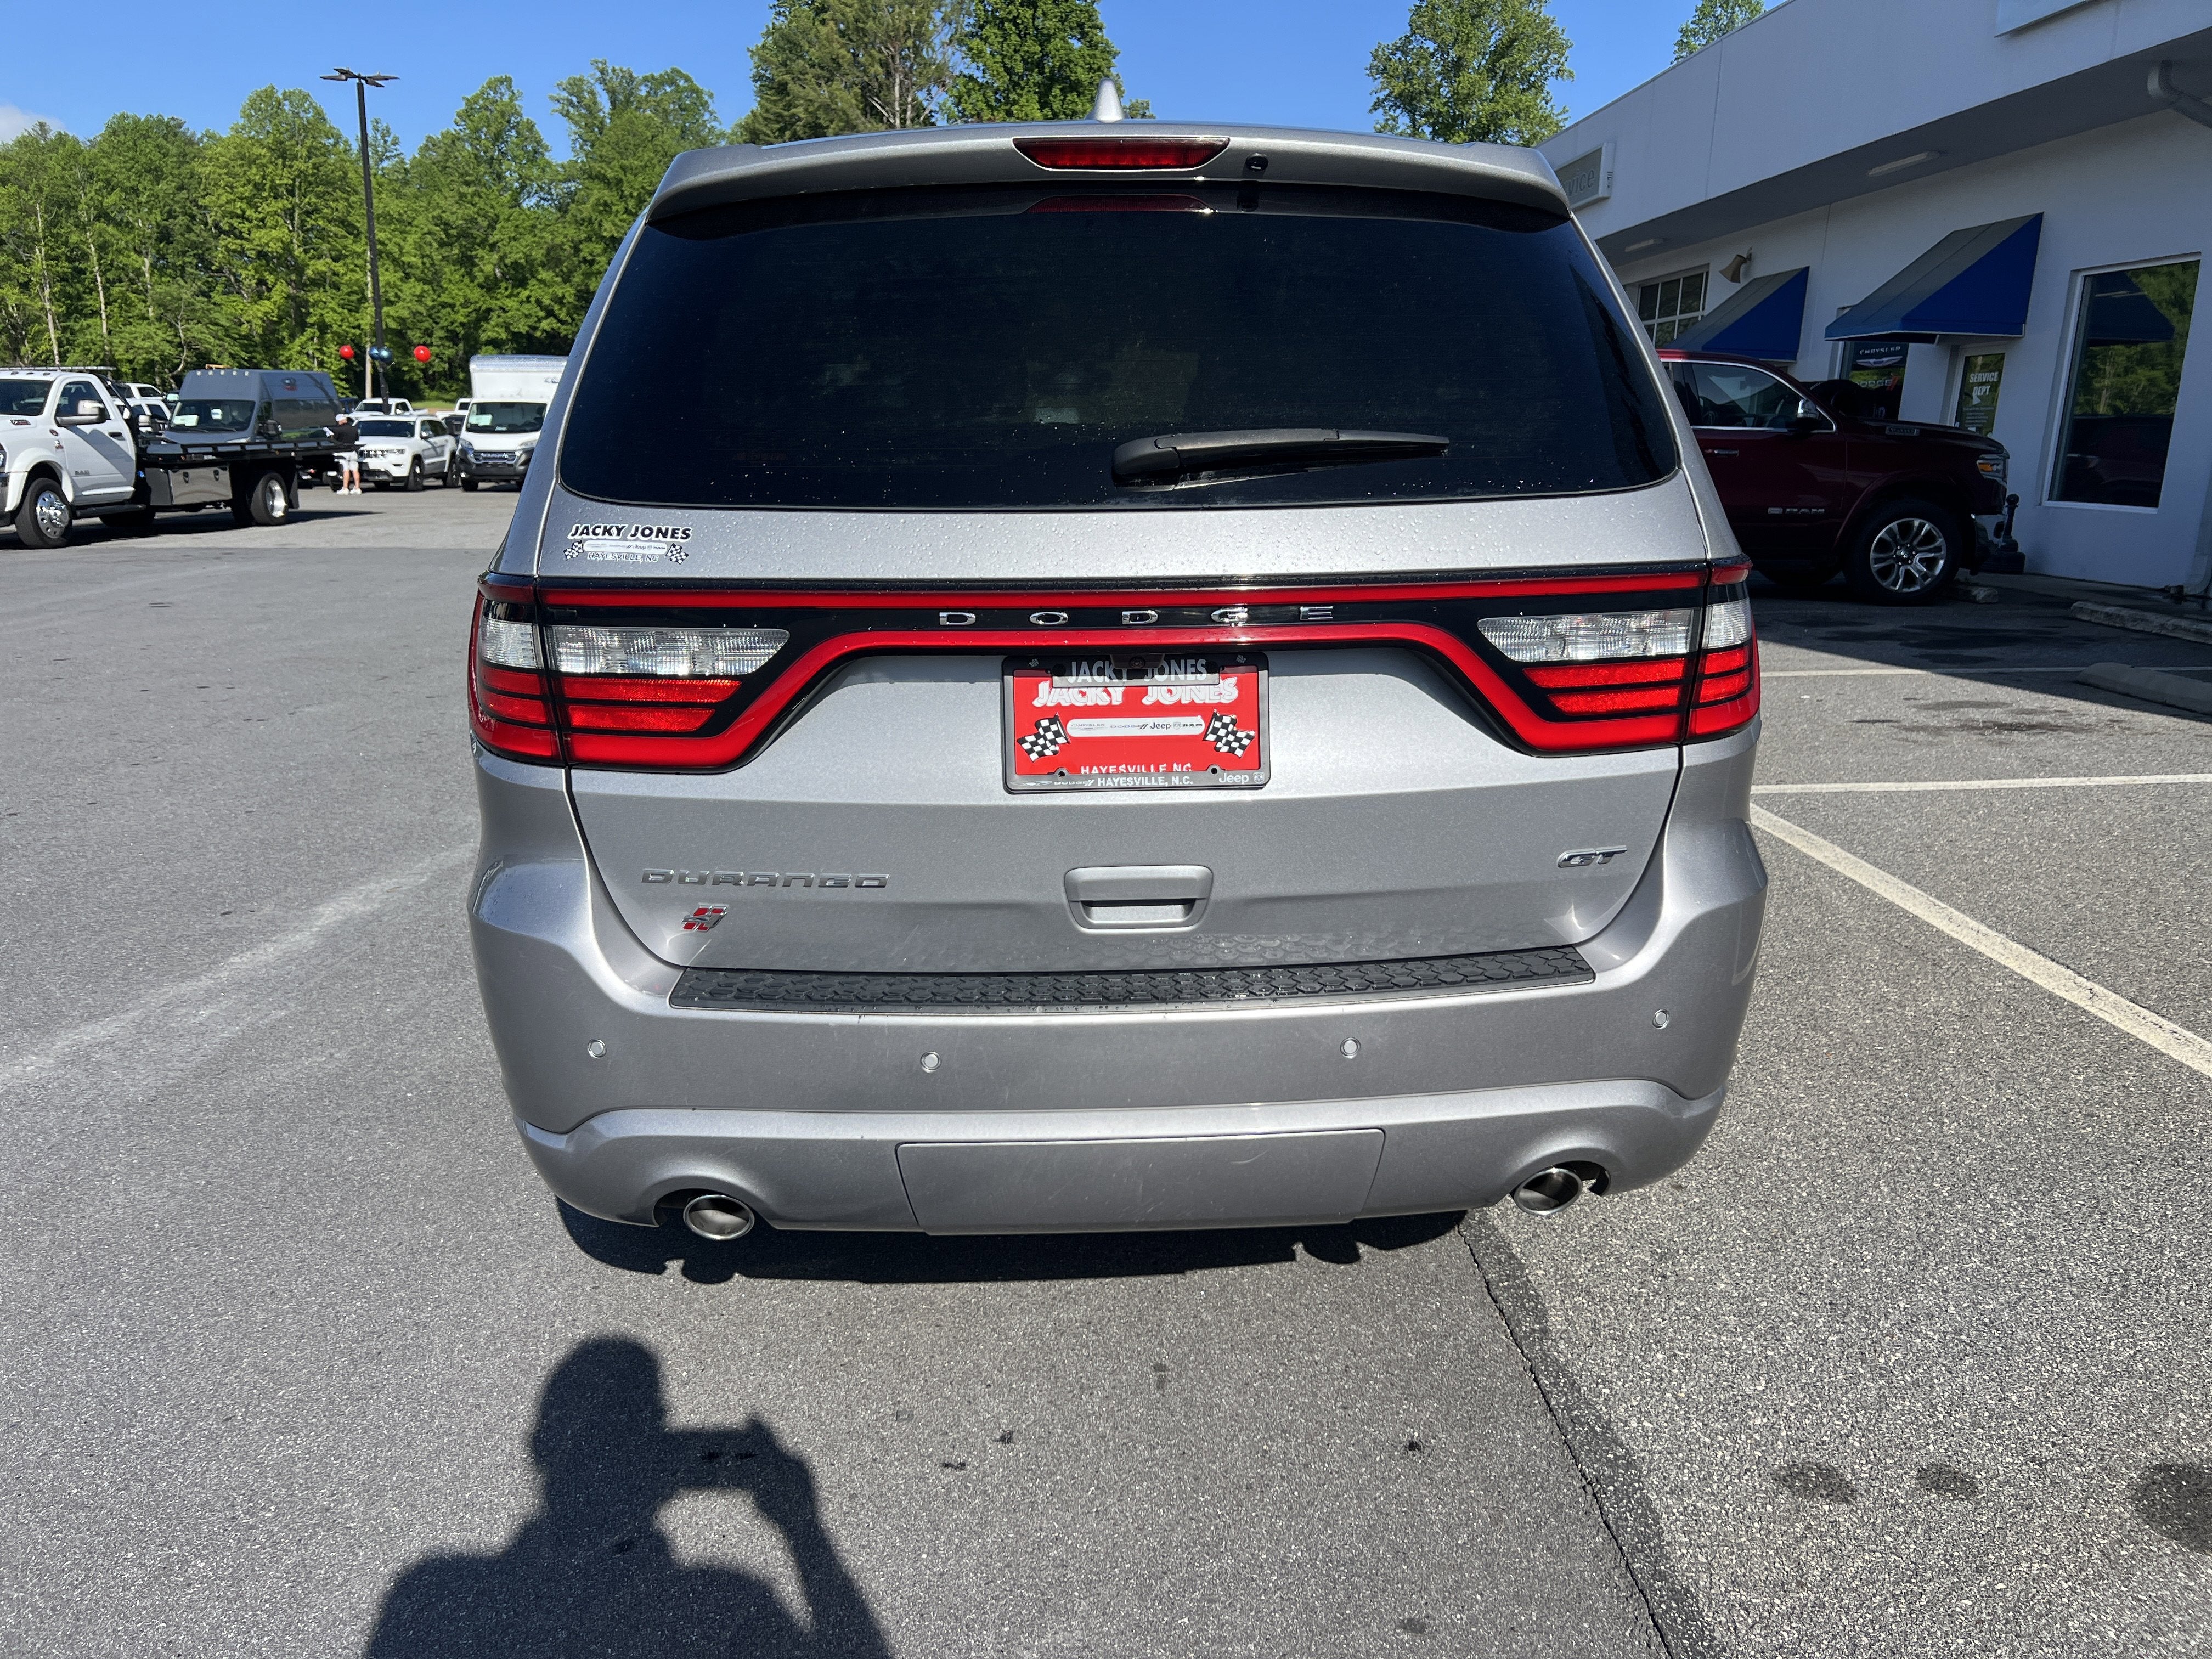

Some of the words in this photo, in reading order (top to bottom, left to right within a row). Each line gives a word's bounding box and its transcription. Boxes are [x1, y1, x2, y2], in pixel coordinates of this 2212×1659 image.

[1567, 170, 1595, 196] vice
[1857, 379, 1893, 387] ODGE
[1969, 371, 1999, 383] SERVICE
[1973, 386, 1991, 396] DEPT
[567, 523, 628, 540] JACKY
[627, 525, 692, 542] JONES
[588, 552, 643, 562] HAYESVILLE,
[645, 554, 659, 562] NC
[939, 606, 1334, 626] DODGE
[1068, 660, 1127, 683] JACKY
[1144, 658, 1207, 682] JONES
[1032, 683, 1126, 707] JACKY
[1141, 678, 1238, 706] JONES
[1149, 722, 1171, 731] Jeep
[1098, 776, 1169, 787] HAYESVILLE,
[1171, 775, 1194, 785] N.C.
[1218, 772, 1250, 784] Jeep
[1556, 845, 1628, 868] GT
[641, 868, 890, 888] DURANGO
